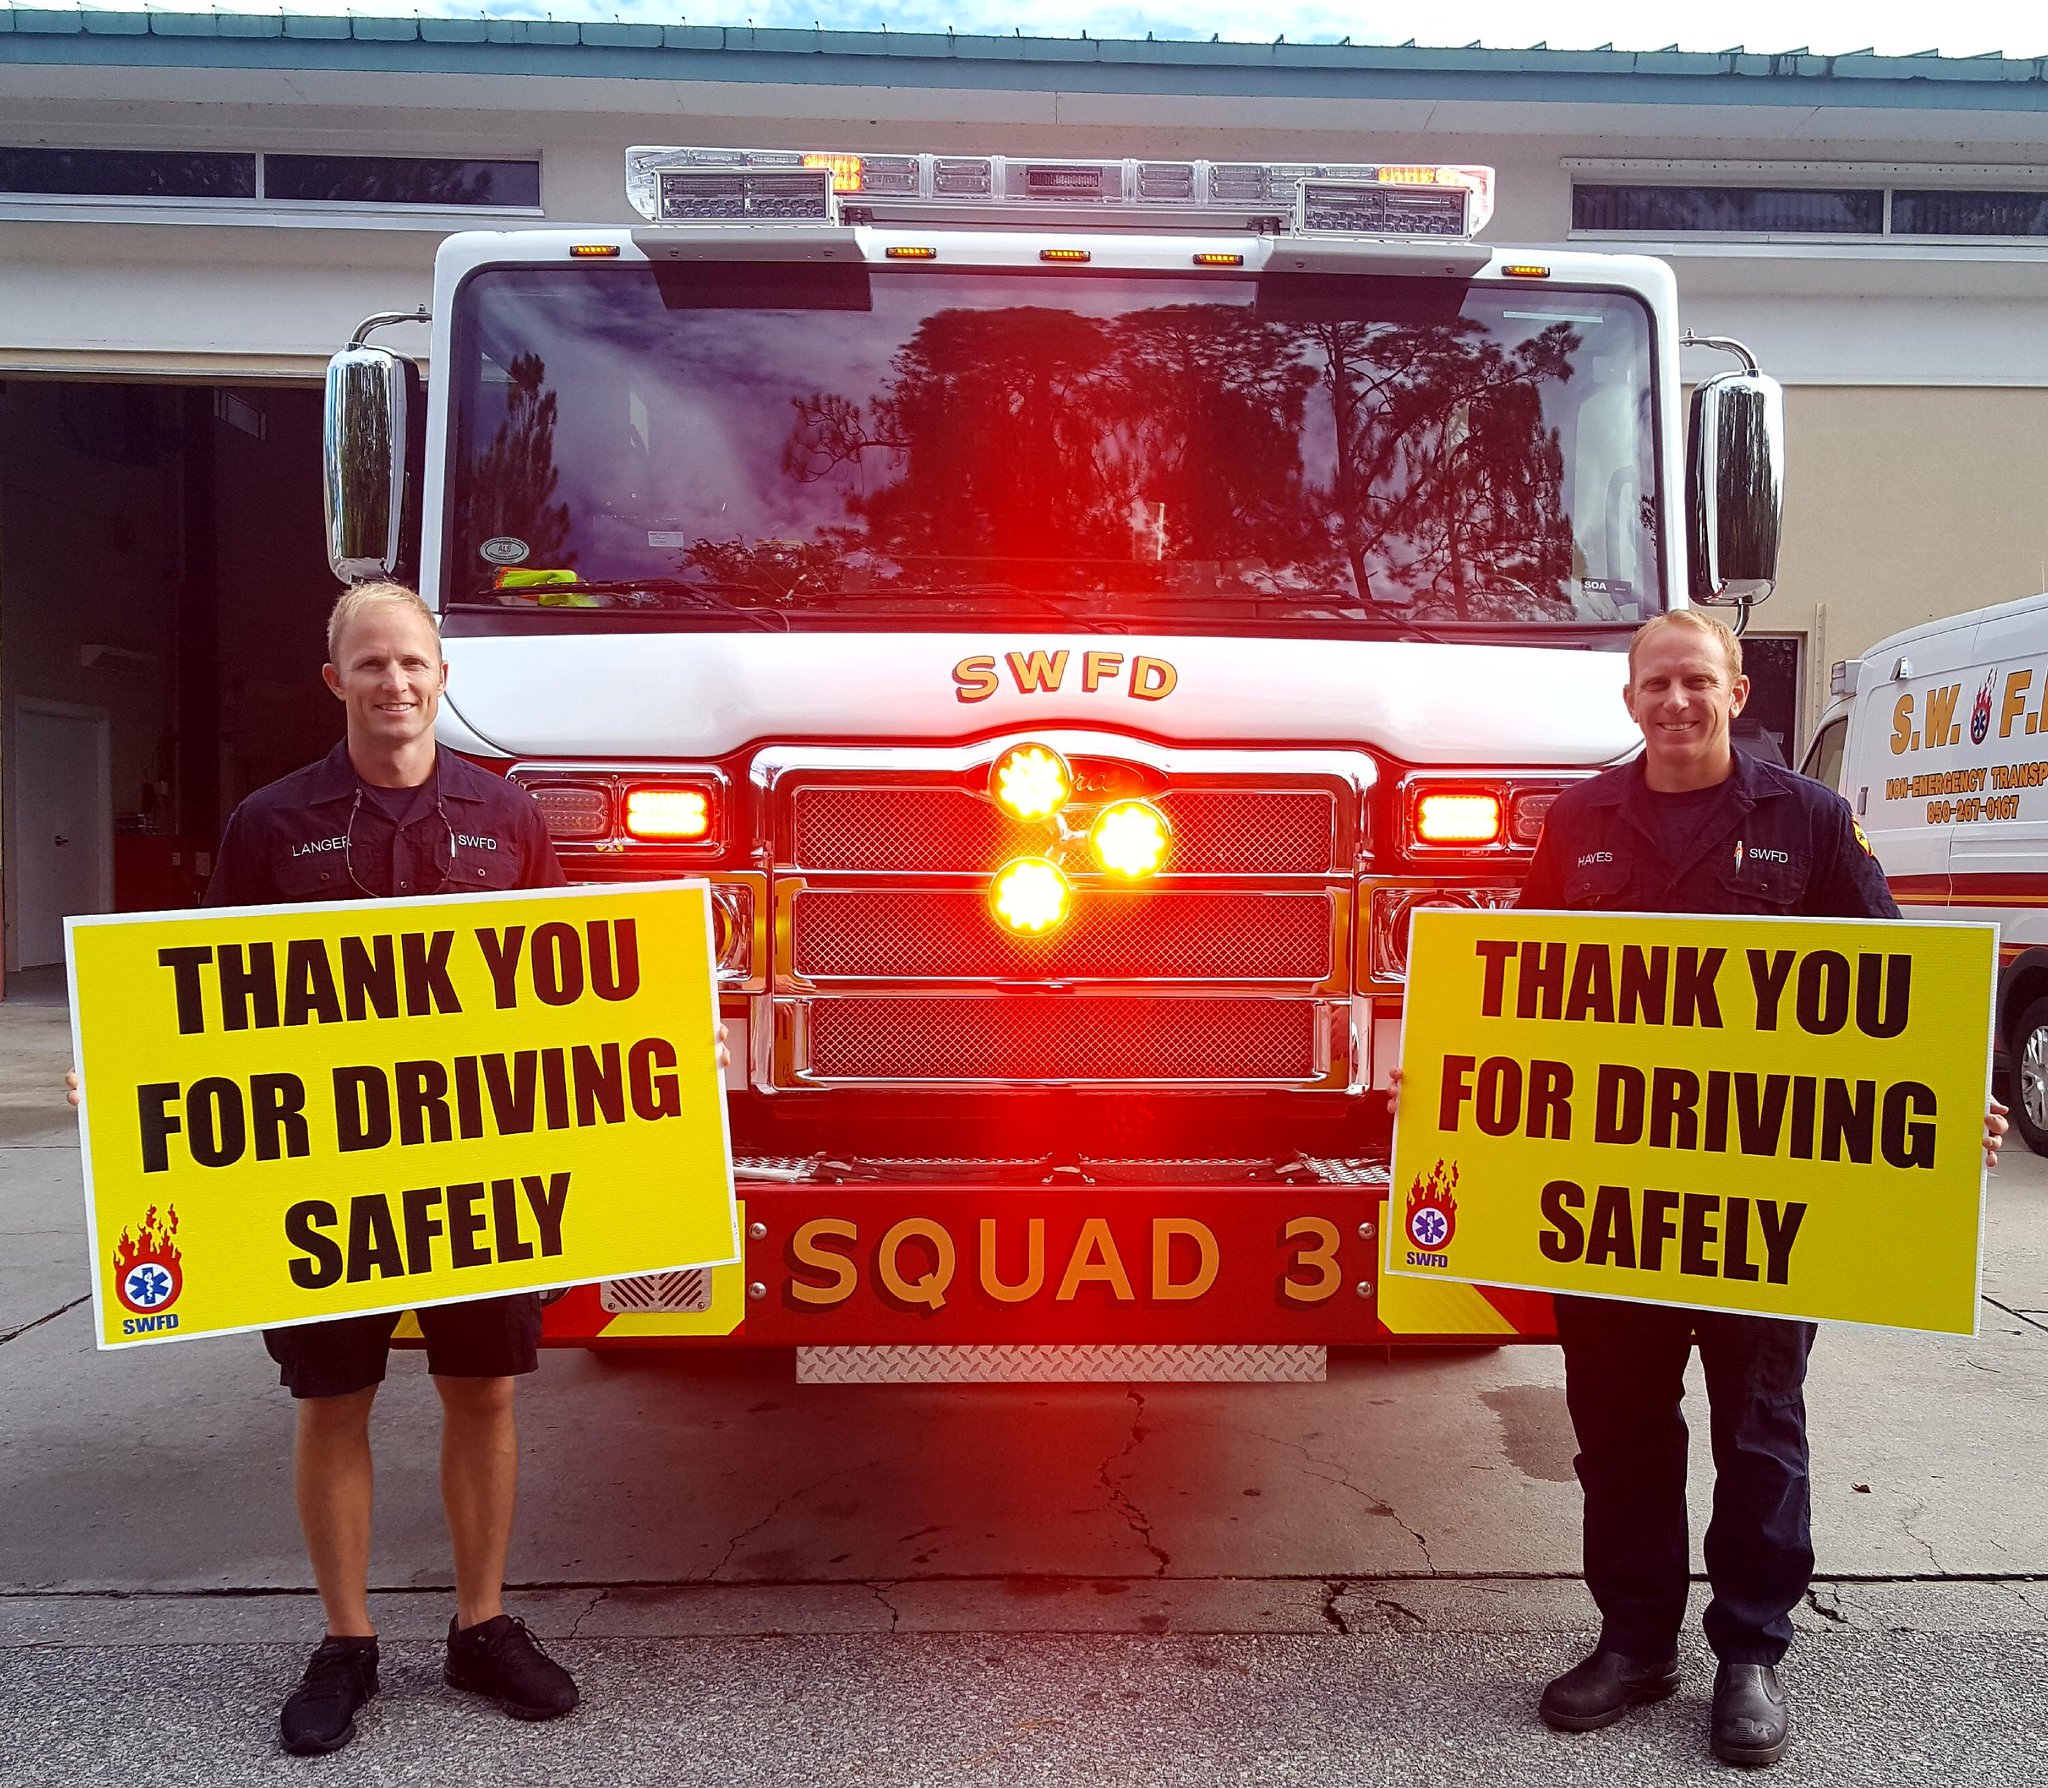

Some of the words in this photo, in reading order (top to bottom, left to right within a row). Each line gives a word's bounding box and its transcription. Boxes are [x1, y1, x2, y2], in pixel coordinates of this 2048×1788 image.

[1584, 580, 1607, 591] SOA
[952, 648, 1179, 704] SWFD
[1889, 683, 1961, 755] S.W.
[1999, 669, 2048, 738] F.
[1886, 767, 1986, 800] NON-EMERGENCY
[1927, 796, 2019, 824] 850-267-0167
[291, 835, 352, 858] LANGER
[458, 834, 497, 851] SWFD
[1577, 851, 1614, 868] HAYES
[1749, 847, 1789, 864] SWFD
[158, 931, 463, 1034] THANK
[475, 918, 640, 1009] YOU
[1475, 939, 1728, 1029] THANK
[1746, 947, 1912, 1039] YOU
[137, 1072, 310, 1173] FOR
[332, 1037, 682, 1153] DRIVING
[1438, 1054, 1574, 1141] FOR
[1594, 1063, 1938, 1170] DRIVING
[284, 1172, 571, 1289] SAFELY
[1538, 1179, 1808, 1285] SAFELY
[786, 1216, 1221, 1311] SQUAD
[1280, 1216, 1342, 1304] 3
[1406, 1251, 1448, 1268] SWFD
[122, 1313, 179, 1335] SWFD
